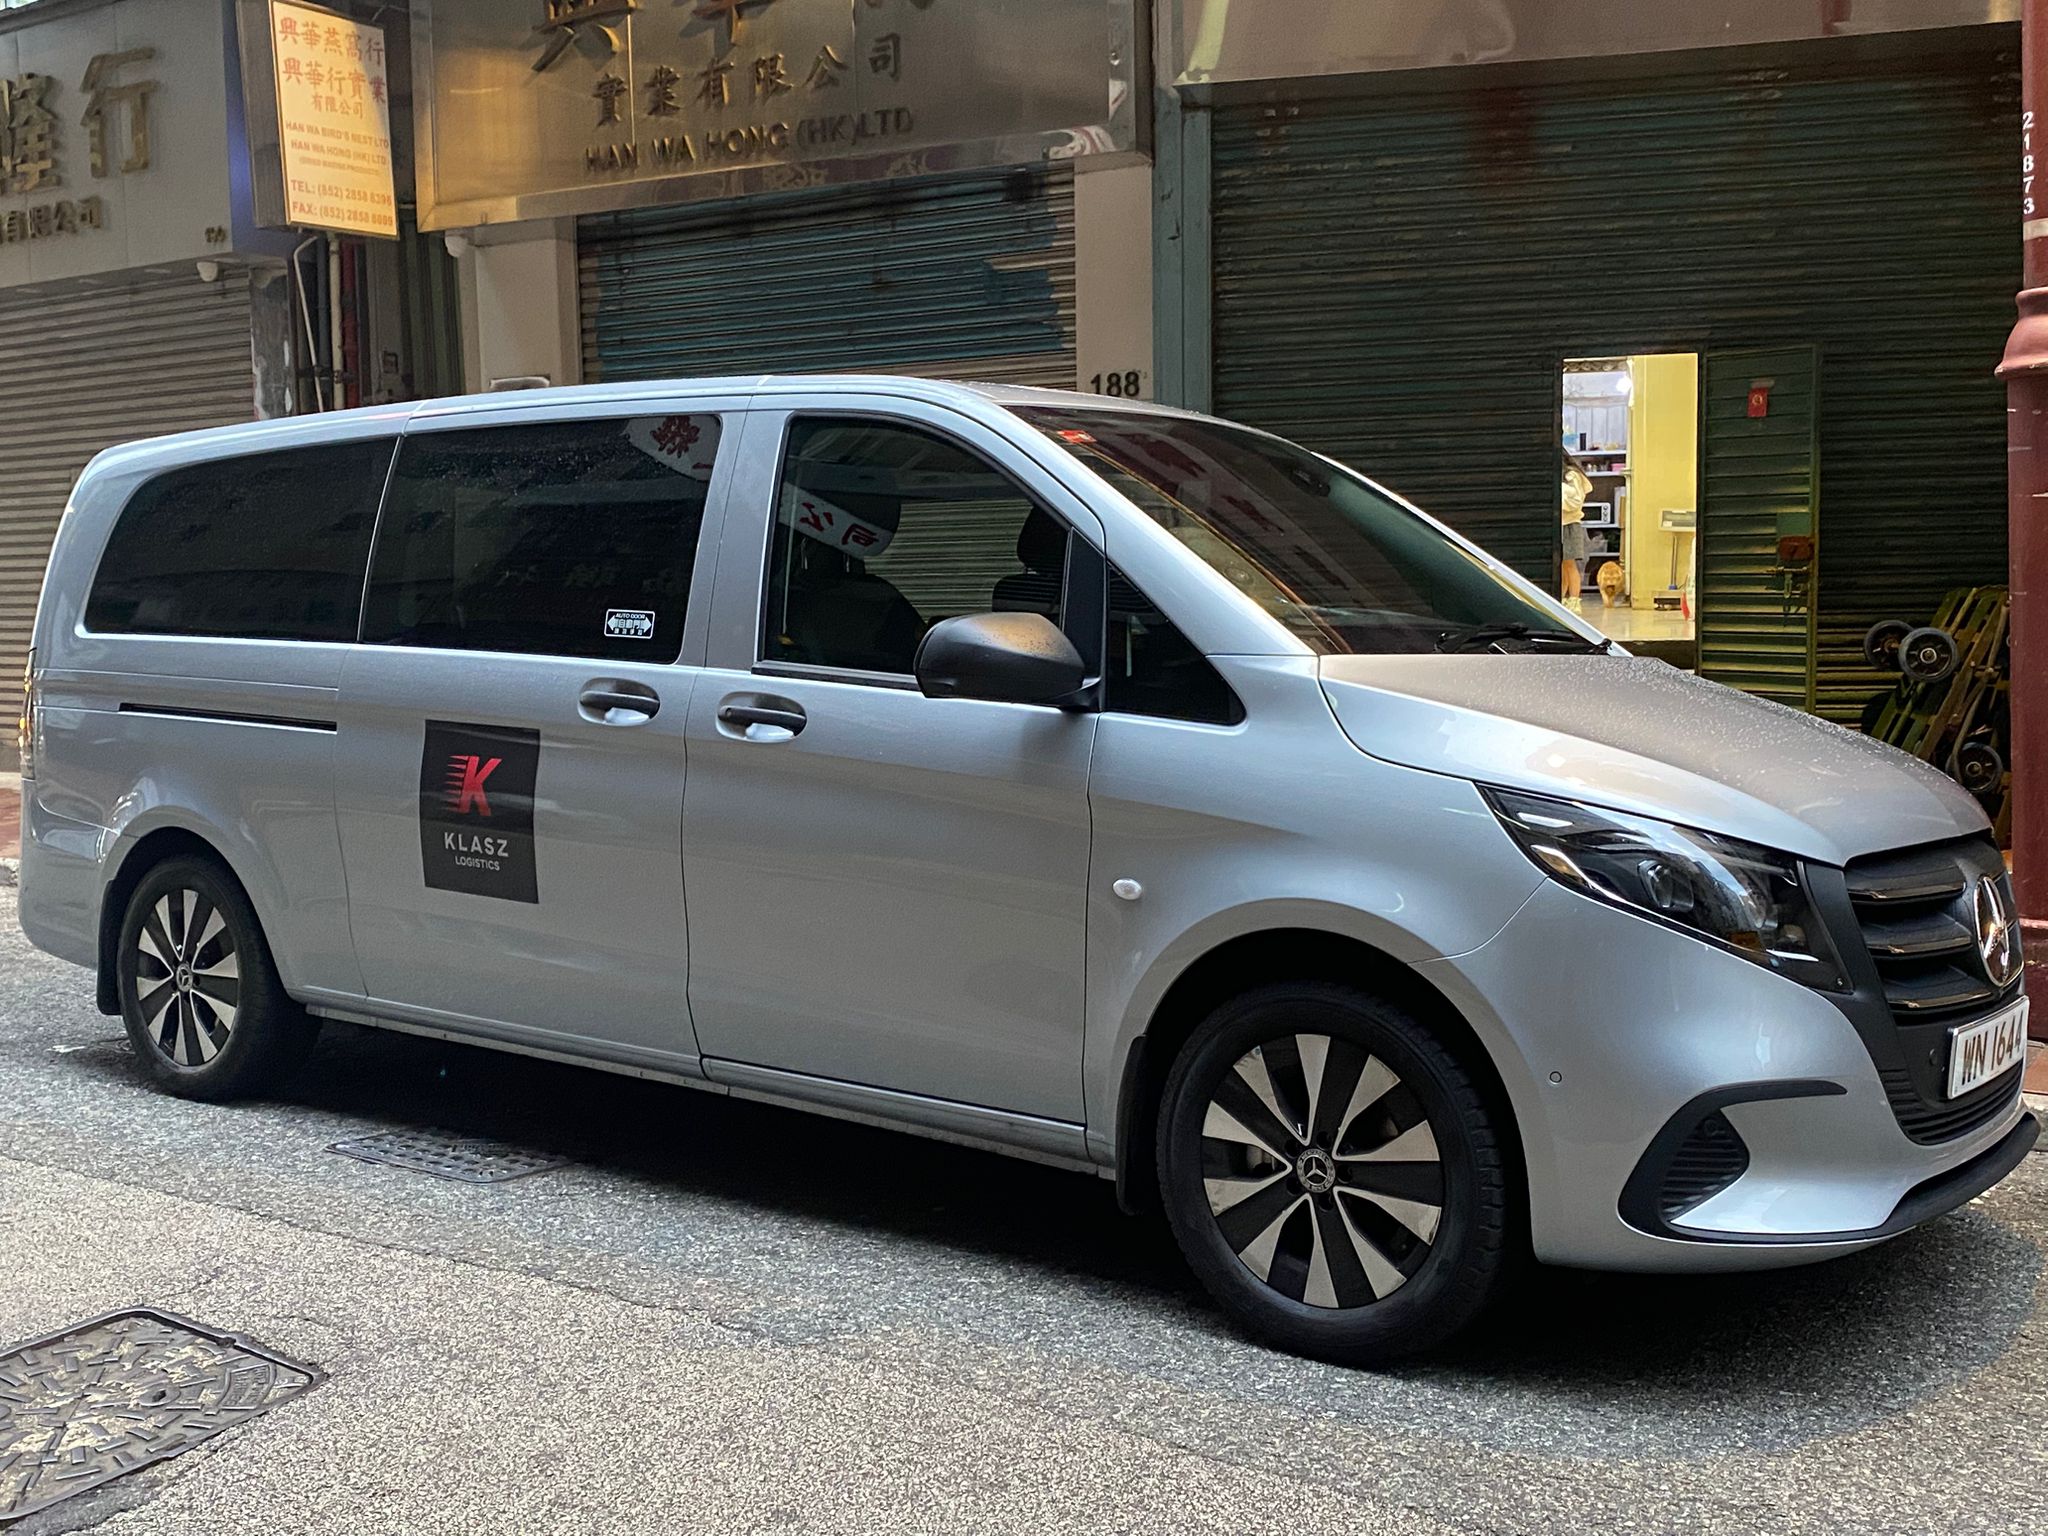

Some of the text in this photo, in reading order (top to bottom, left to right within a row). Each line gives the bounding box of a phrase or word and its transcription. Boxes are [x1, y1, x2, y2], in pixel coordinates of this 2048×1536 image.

[279, 17, 384, 66] 興華燕窩行
[283, 57, 386, 104] 興華行實業
[591, 31, 901, 128] 實業有限公司
[312, 93, 364, 120] 有限公司
[286, 121, 304, 132] HAN
[306, 124, 320, 135] WA
[291, 139, 310, 151] HAN
[311, 143, 325, 154] WA
[327, 145, 351, 159] HONG
[585, 143, 639, 171] HAN
[652, 134, 696, 163] WA
[705, 121, 790, 159] HONG
[291, 179, 315, 195] TEL:
[318, 183, 344, 200] (852)
[0, 197, 103, 244] 有限公司
[292, 201, 317, 216] FAX:
[320, 205, 345, 221] (852)
[1090, 371, 1140, 397] 188
[448, 756, 503, 816] K
[444, 832, 509, 857] KLASZ
[455, 855, 500, 871] LOGISTICS
[1962, 1009, 2024, 1086] WN 1644
